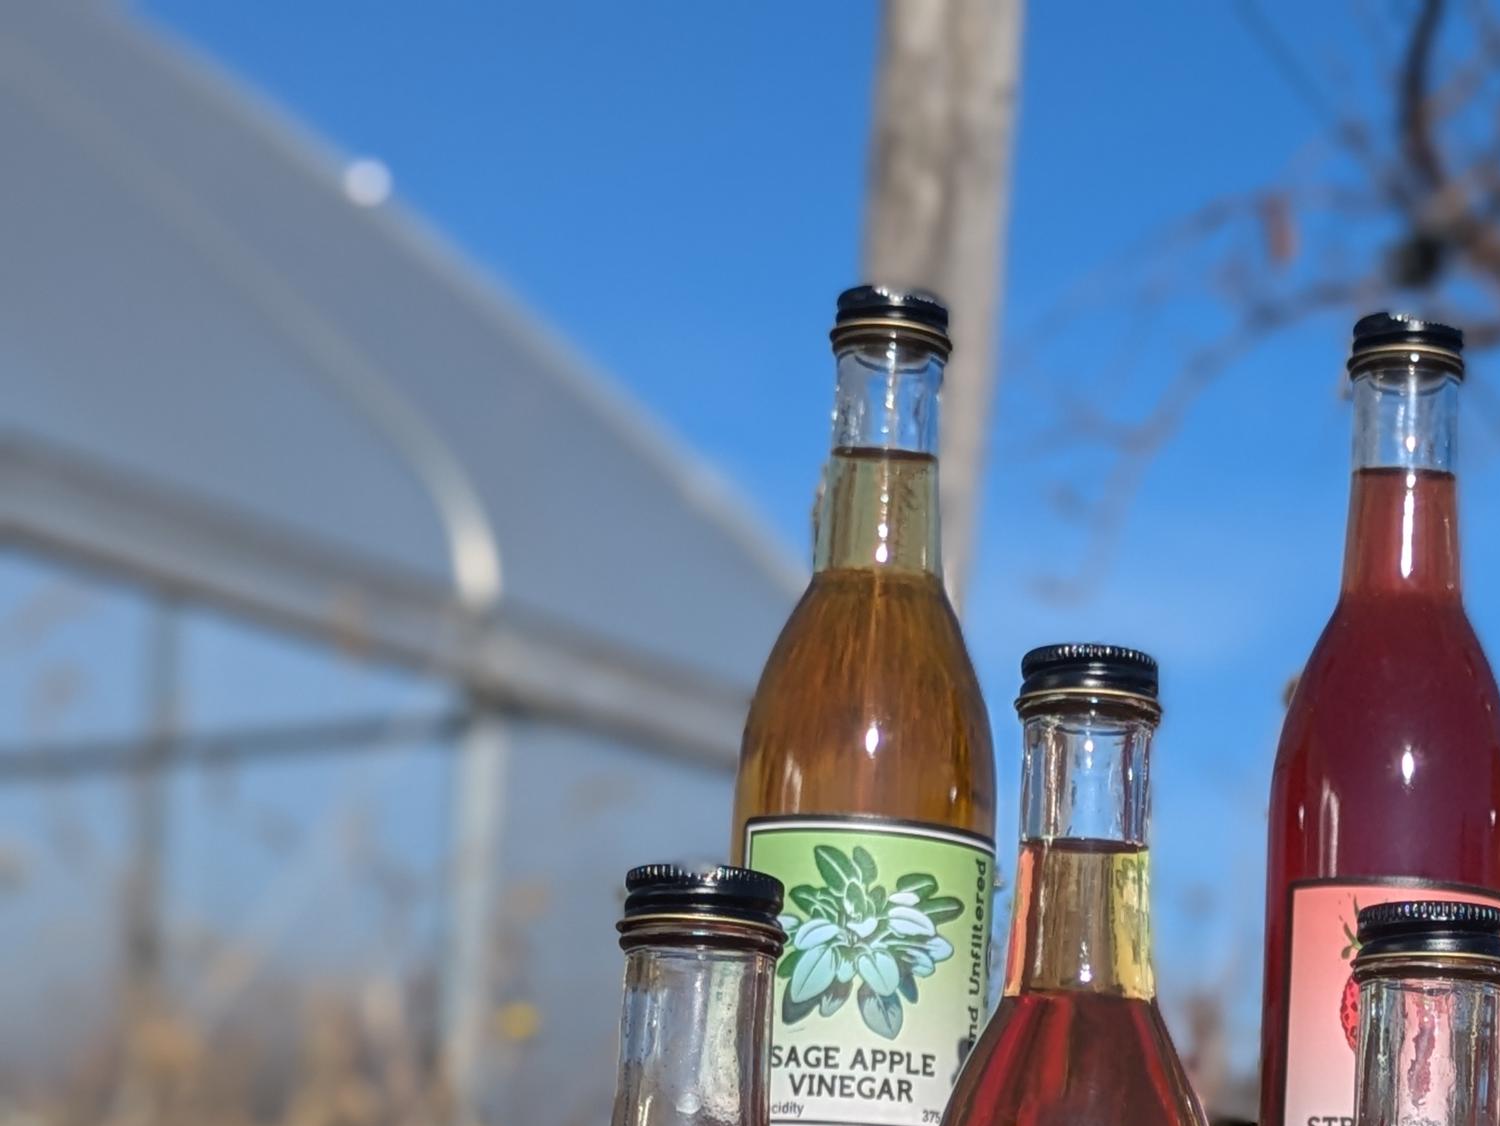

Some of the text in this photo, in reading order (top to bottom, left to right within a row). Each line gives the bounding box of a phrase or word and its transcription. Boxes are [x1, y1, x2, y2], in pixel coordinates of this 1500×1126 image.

[968, 858, 986, 996] Unfiltered
[967, 1006, 978, 1047] nd
[771, 1045, 936, 1077] SAGE APPLE
[789, 1073, 913, 1103] VINEGAR
[771, 1101, 941, 1124] cidity 375
